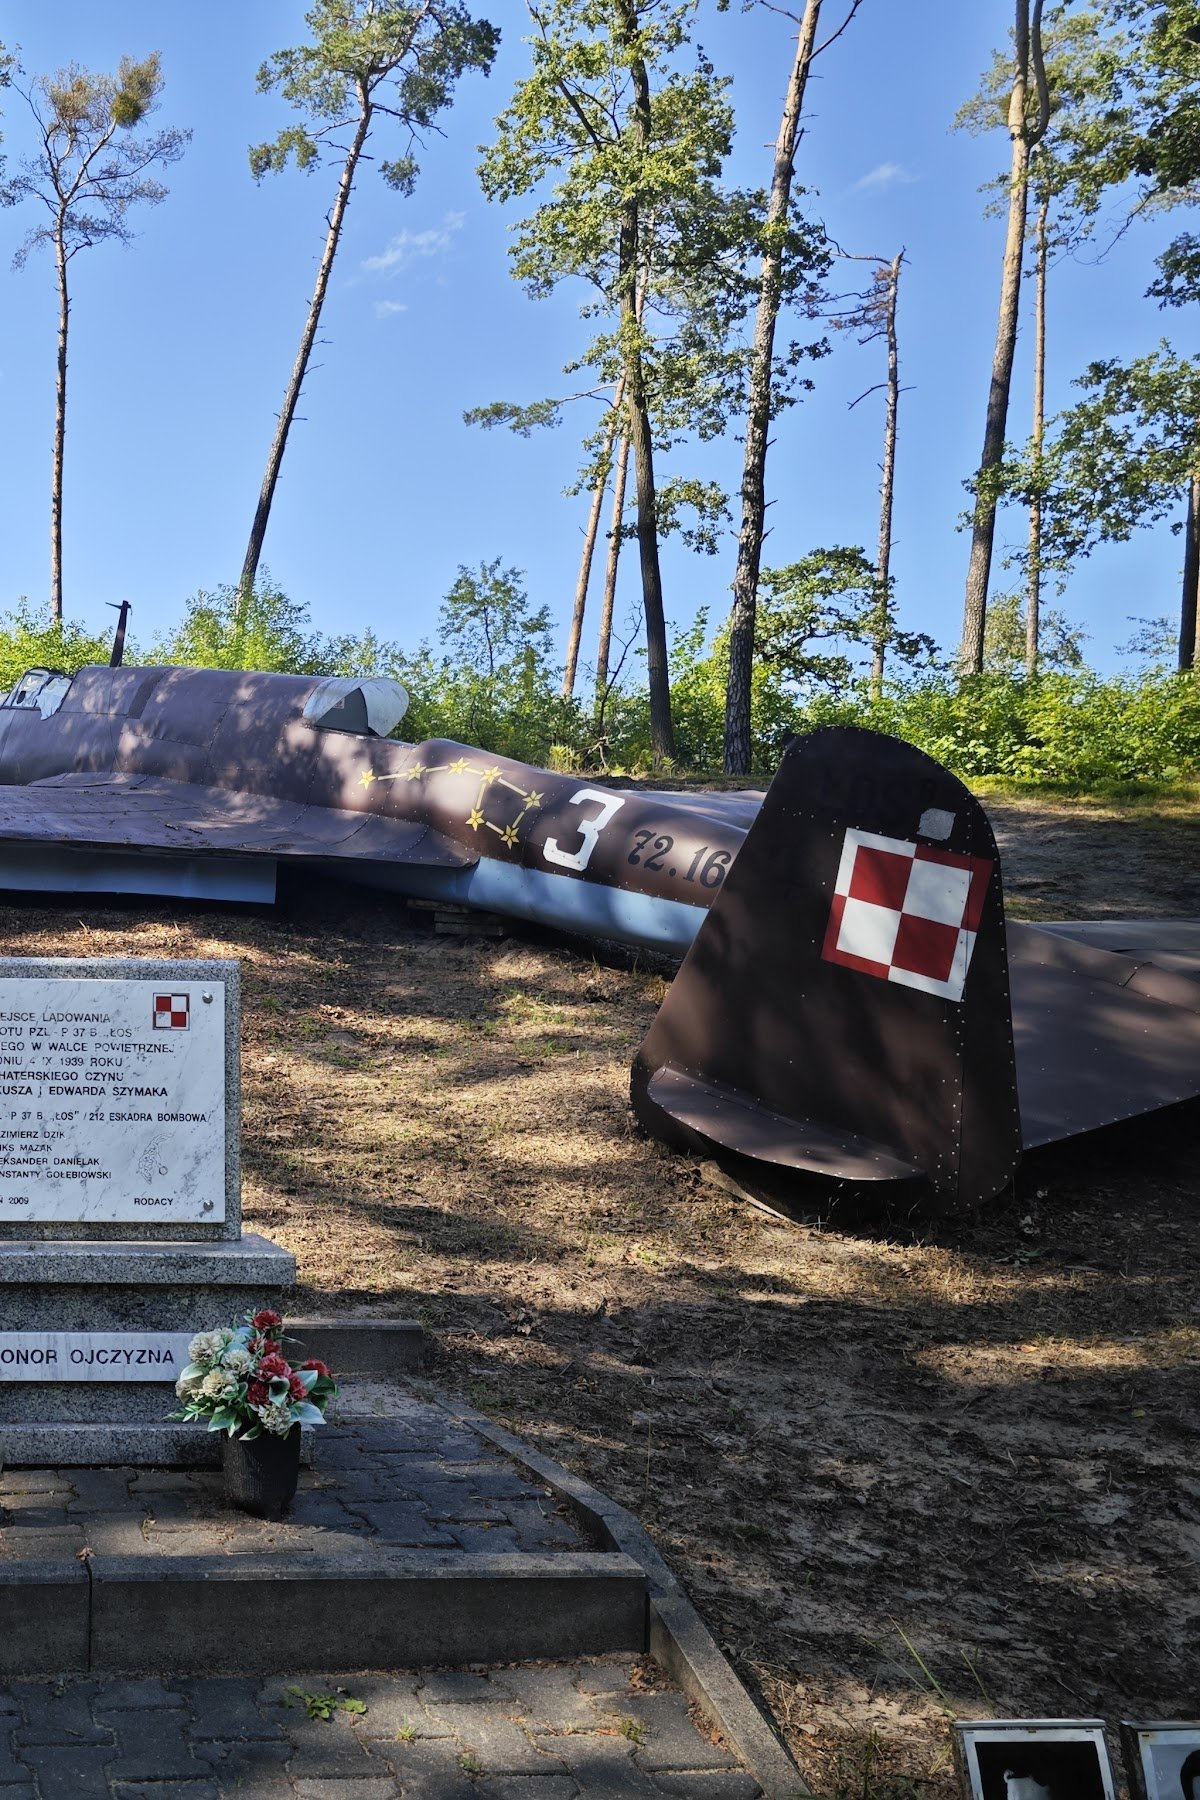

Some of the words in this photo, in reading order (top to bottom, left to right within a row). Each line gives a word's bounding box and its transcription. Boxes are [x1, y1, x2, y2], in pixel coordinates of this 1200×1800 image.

[542, 788, 625, 872] 3
[627, 829, 732, 889] 72.16
[29, 1027, 51, 1036] PZL
[61, 1028, 68, 1037] P
[73, 1028, 85, 1037] 37
[31, 1042, 42, 1051] W
[48, 1043, 88, 1052] WALCE
[95, 1043, 175, 1053] POWIETRZNEJ
[60, 1057, 84, 1066] 1939
[90, 1058, 123, 1067] ROKU
[85, 1071, 124, 1082] CZYNU
[49, 1086, 106, 1096] EDWARDA
[112, 1087, 168, 1096] SZYMAKA
[10, 1112, 17, 1120] P
[21, 1112, 32, 1120] 37
[37, 1112, 43, 1120] B
[109, 1113, 153, 1122] ESKADRA
[43, 1131, 66, 1139] DZIK
[54, 1158, 100, 1166] DANIELAK
[8, 1197, 29, 1205] 2009
[134, 1198, 173, 1206] RODACY
[70, 1349, 174, 1365] OJCZYZNA
